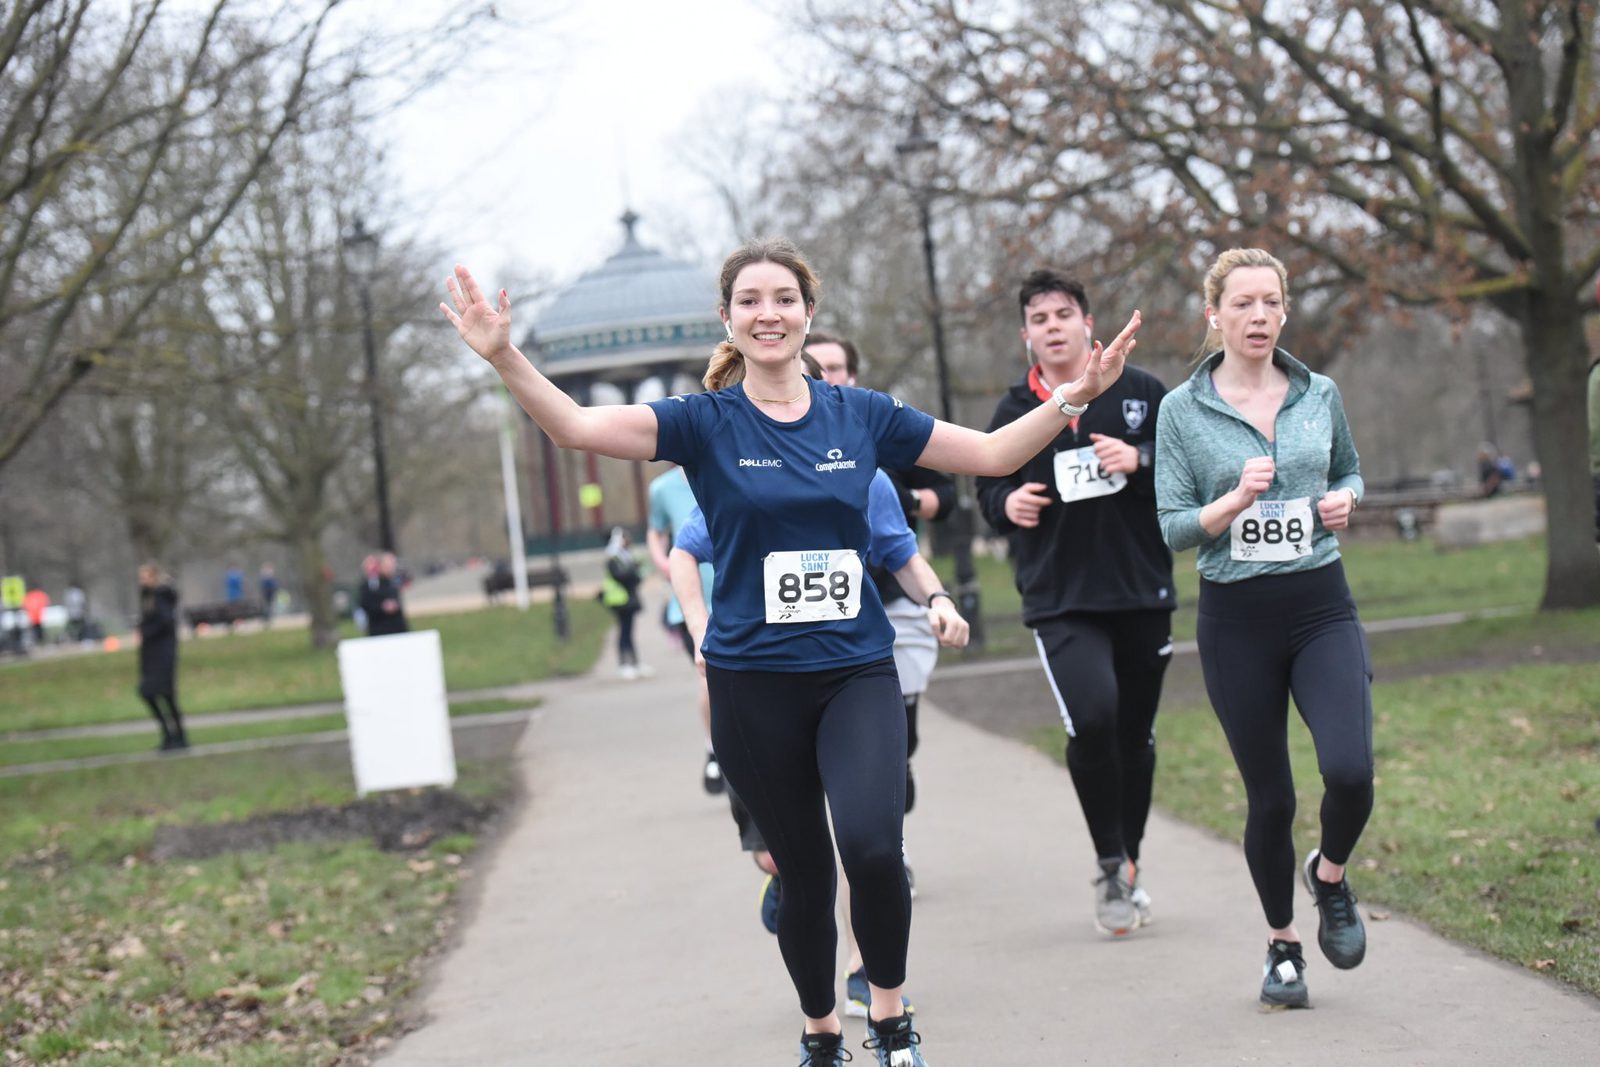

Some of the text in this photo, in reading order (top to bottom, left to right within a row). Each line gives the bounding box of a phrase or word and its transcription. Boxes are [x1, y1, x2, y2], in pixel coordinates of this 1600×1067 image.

[815, 459, 856, 473] Computacenter
[1260, 502, 1286, 510] LUCKY
[1260, 510, 1285, 518] SAINT
[1241, 517, 1304, 544] 888
[800, 552, 830, 562] LUCKY
[801, 562, 830, 572] SAINT
[778, 570, 850, 603] 858
